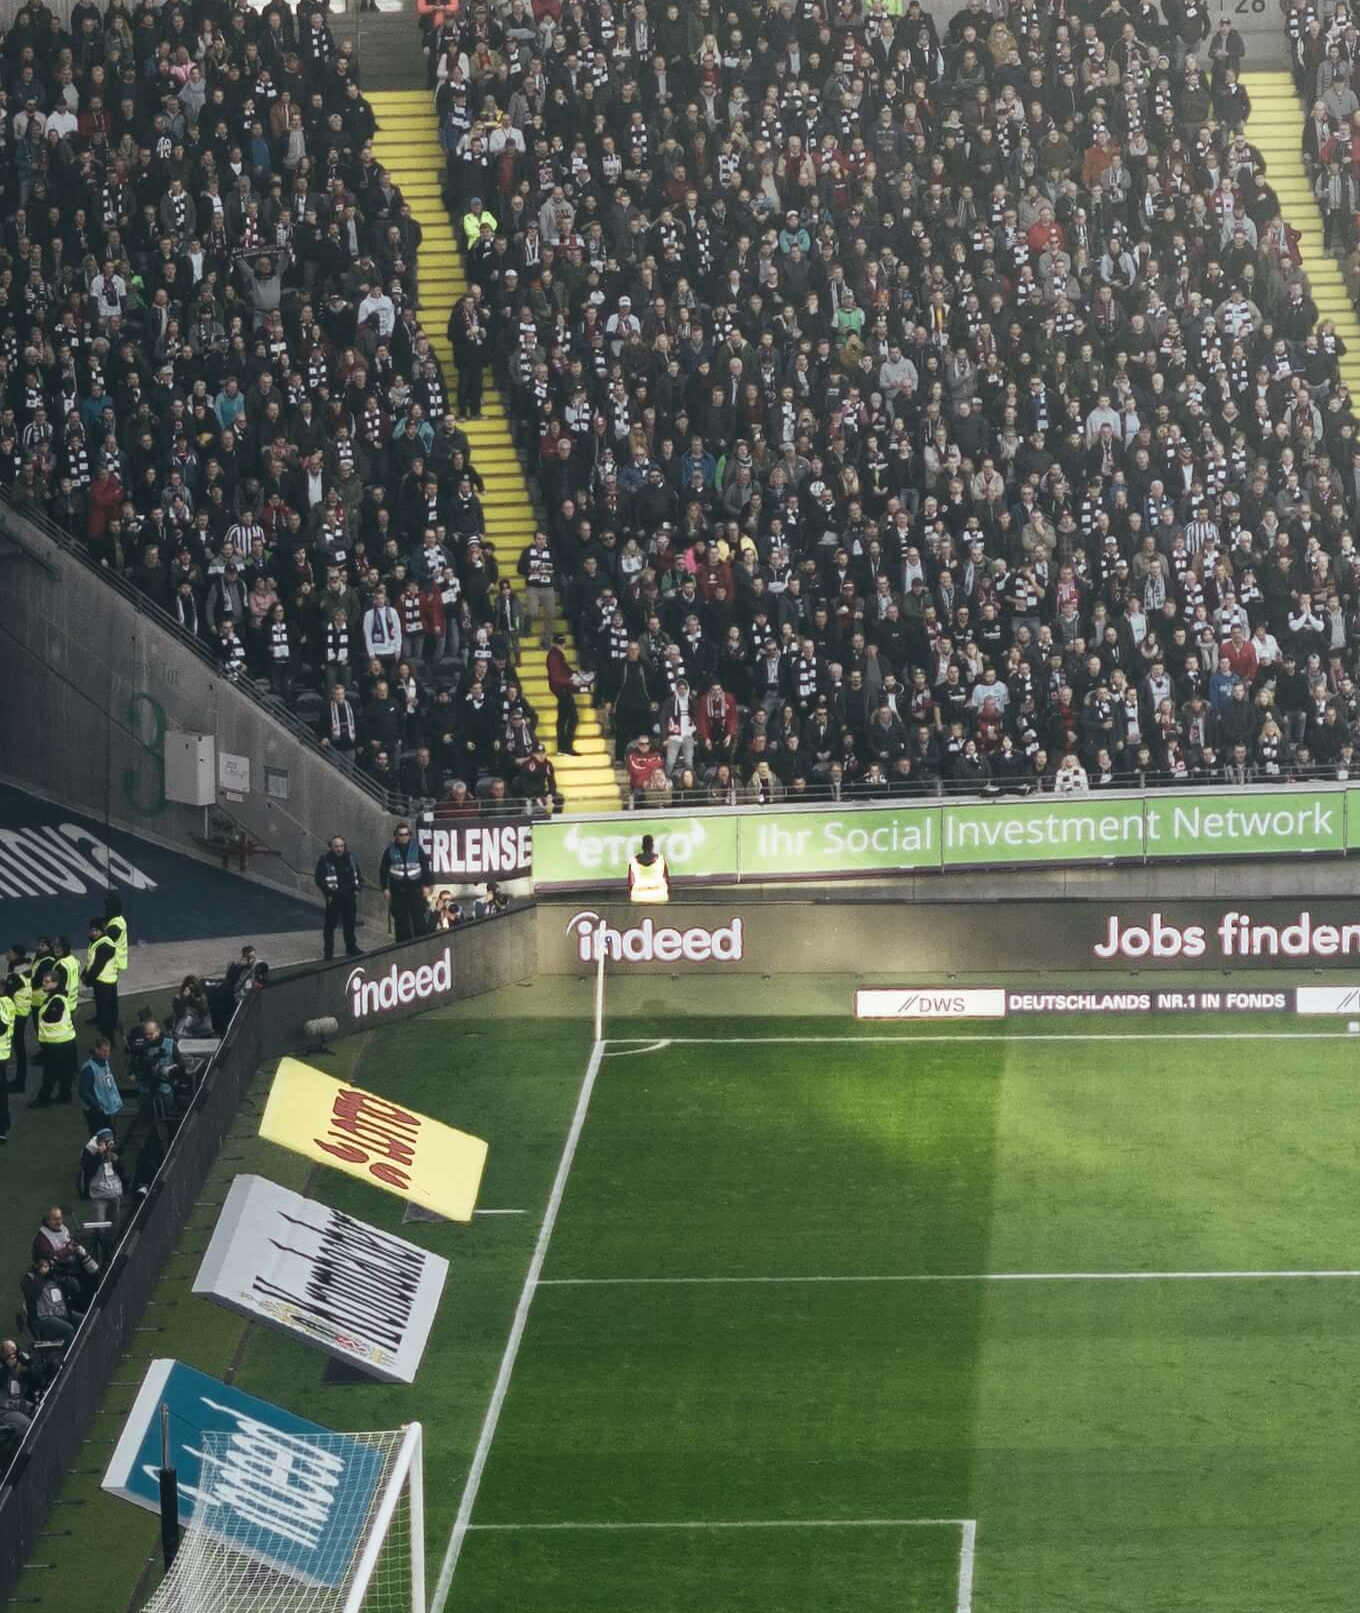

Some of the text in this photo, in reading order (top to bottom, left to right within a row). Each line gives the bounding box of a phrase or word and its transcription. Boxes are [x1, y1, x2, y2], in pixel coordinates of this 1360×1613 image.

[759, 801, 1333, 857] Ihr Social Investment Network
[566, 911, 743, 962] indeed
[1094, 912, 1205, 958] Jobs
[345, 947, 452, 1017] indeed
[919, 994, 966, 1013] DWS
[1009, 992, 1286, 1011] DEUTSCHLANDS NR.1 IN FONDS
[327, 1088, 422, 1166] LOTTO
[252, 1208, 427, 1353] Krombacher
[142, 1397, 346, 1549] indeed
